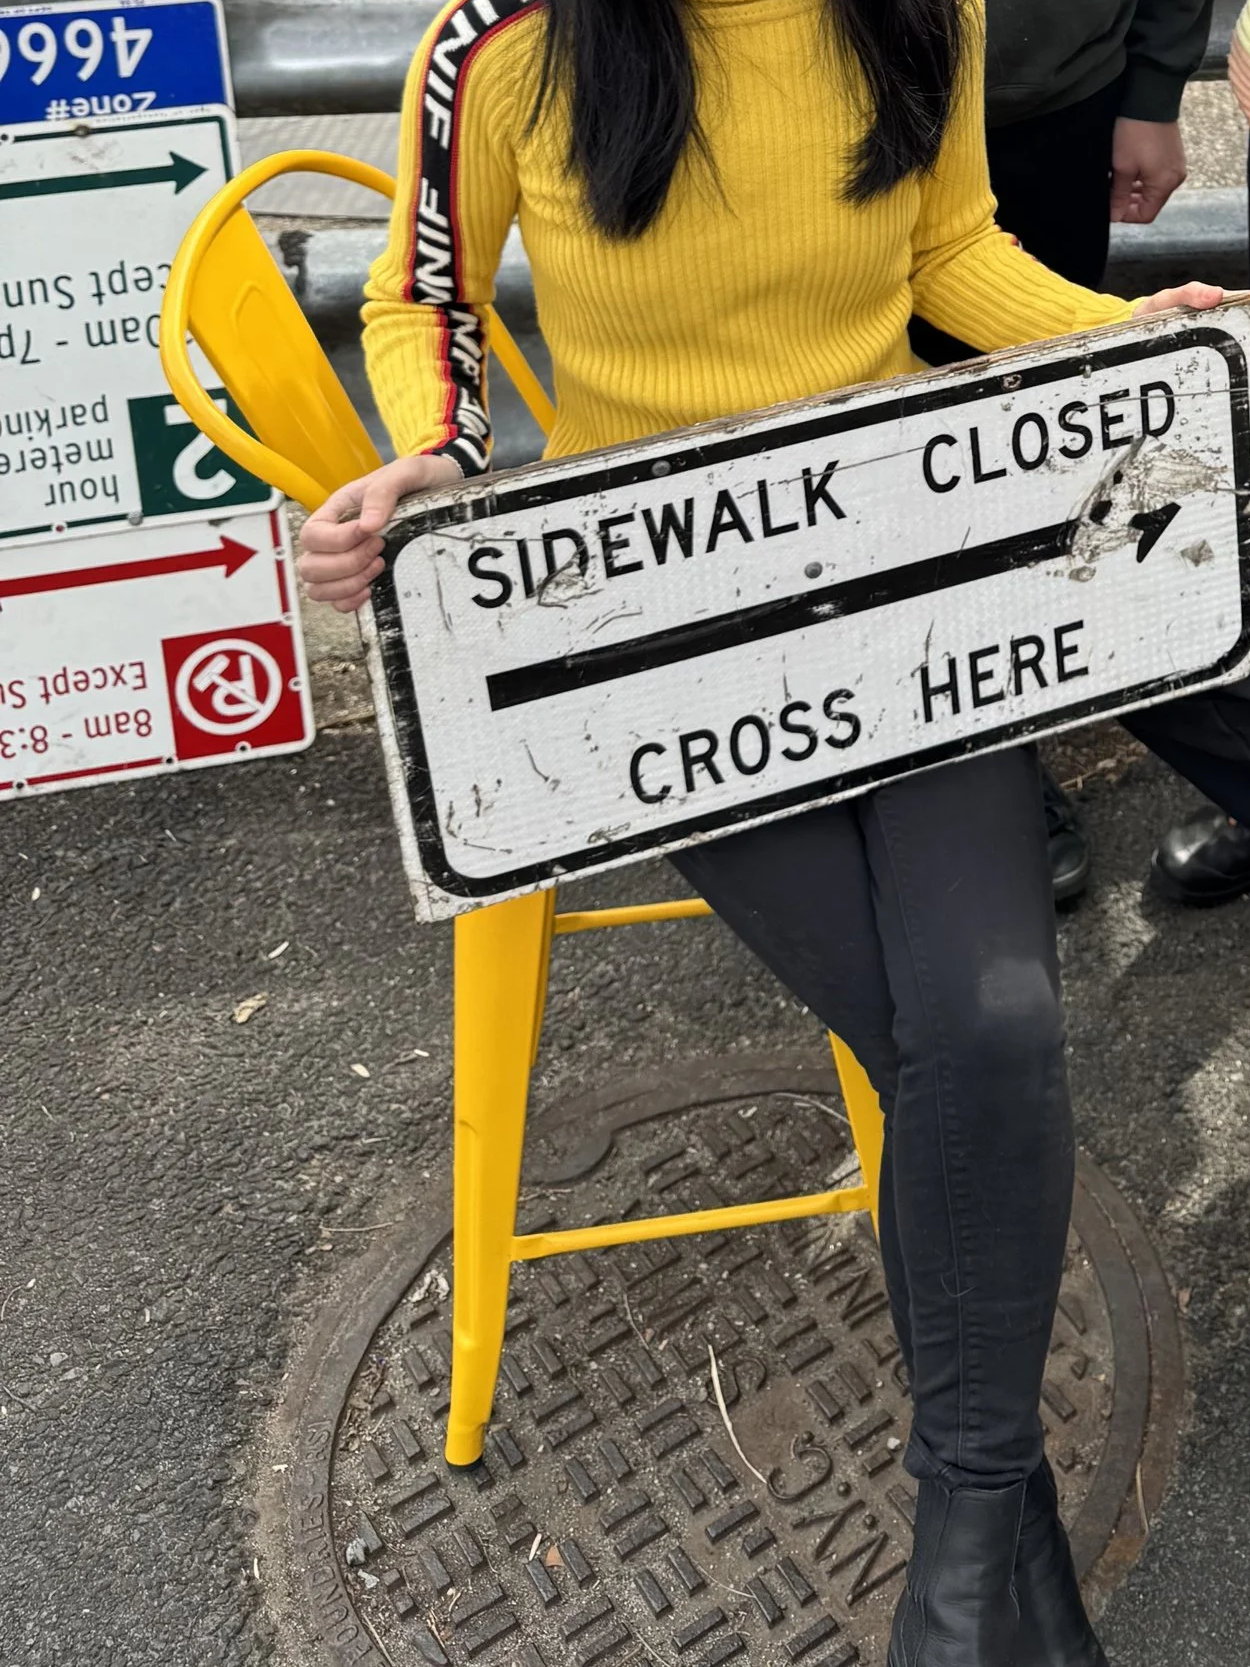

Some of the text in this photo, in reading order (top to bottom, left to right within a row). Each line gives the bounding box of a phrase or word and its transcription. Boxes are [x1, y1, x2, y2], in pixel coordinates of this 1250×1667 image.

[0, 16, 153, 86] 466
[45, 91, 157, 121] Zone#
[3, 260, 173, 310] cept Sun
[84, 313, 194, 348] 0am
[0, 394, 109, 441] parkin
[164, 398, 237, 500] 2
[45, 474, 119, 507] hour
[467, 380, 1175, 609] SIDEWALK CLOSED
[38, 661, 148, 705] Except
[84, 708, 152, 739] 8am
[629, 620, 1089, 804] CROSS HERE
[590, 1200, 767, 1411] SEWE
